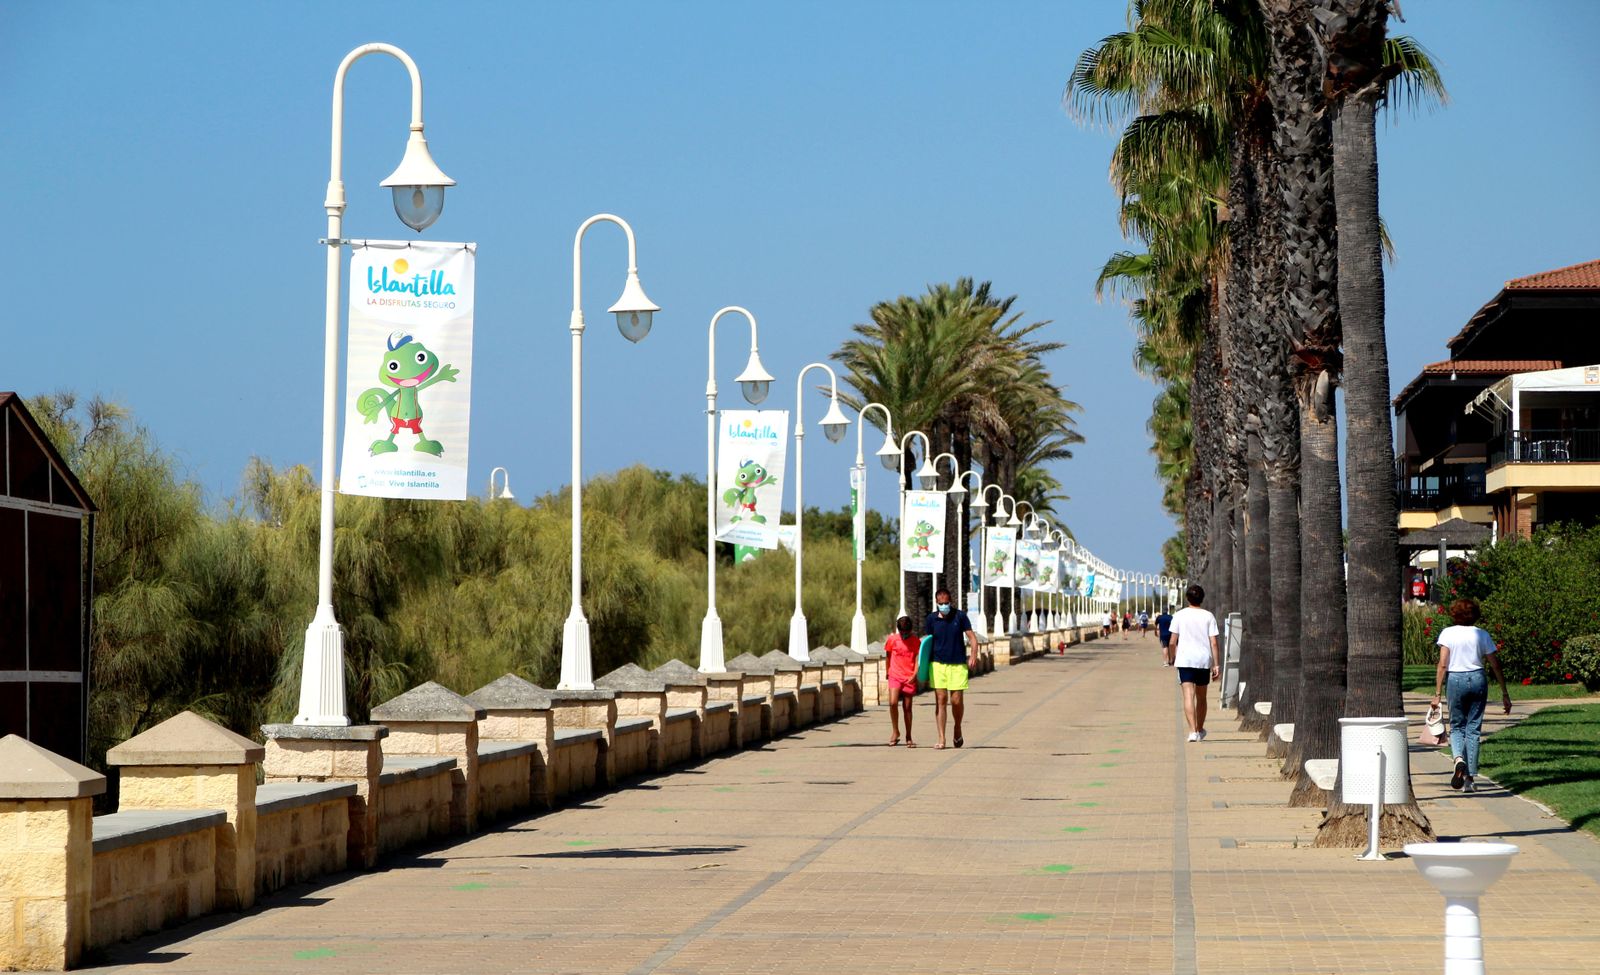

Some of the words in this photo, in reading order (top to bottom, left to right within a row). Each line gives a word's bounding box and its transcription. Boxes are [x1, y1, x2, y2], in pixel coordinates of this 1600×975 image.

[368, 266, 456, 297] Islantilla
[380, 299, 421, 308] DISFRUTAS
[423, 301, 456, 309] SEGURO
[729, 424, 778, 440] Islantilla
[389, 480, 405, 488] Vive
[407, 480, 440, 489] Islantilla
